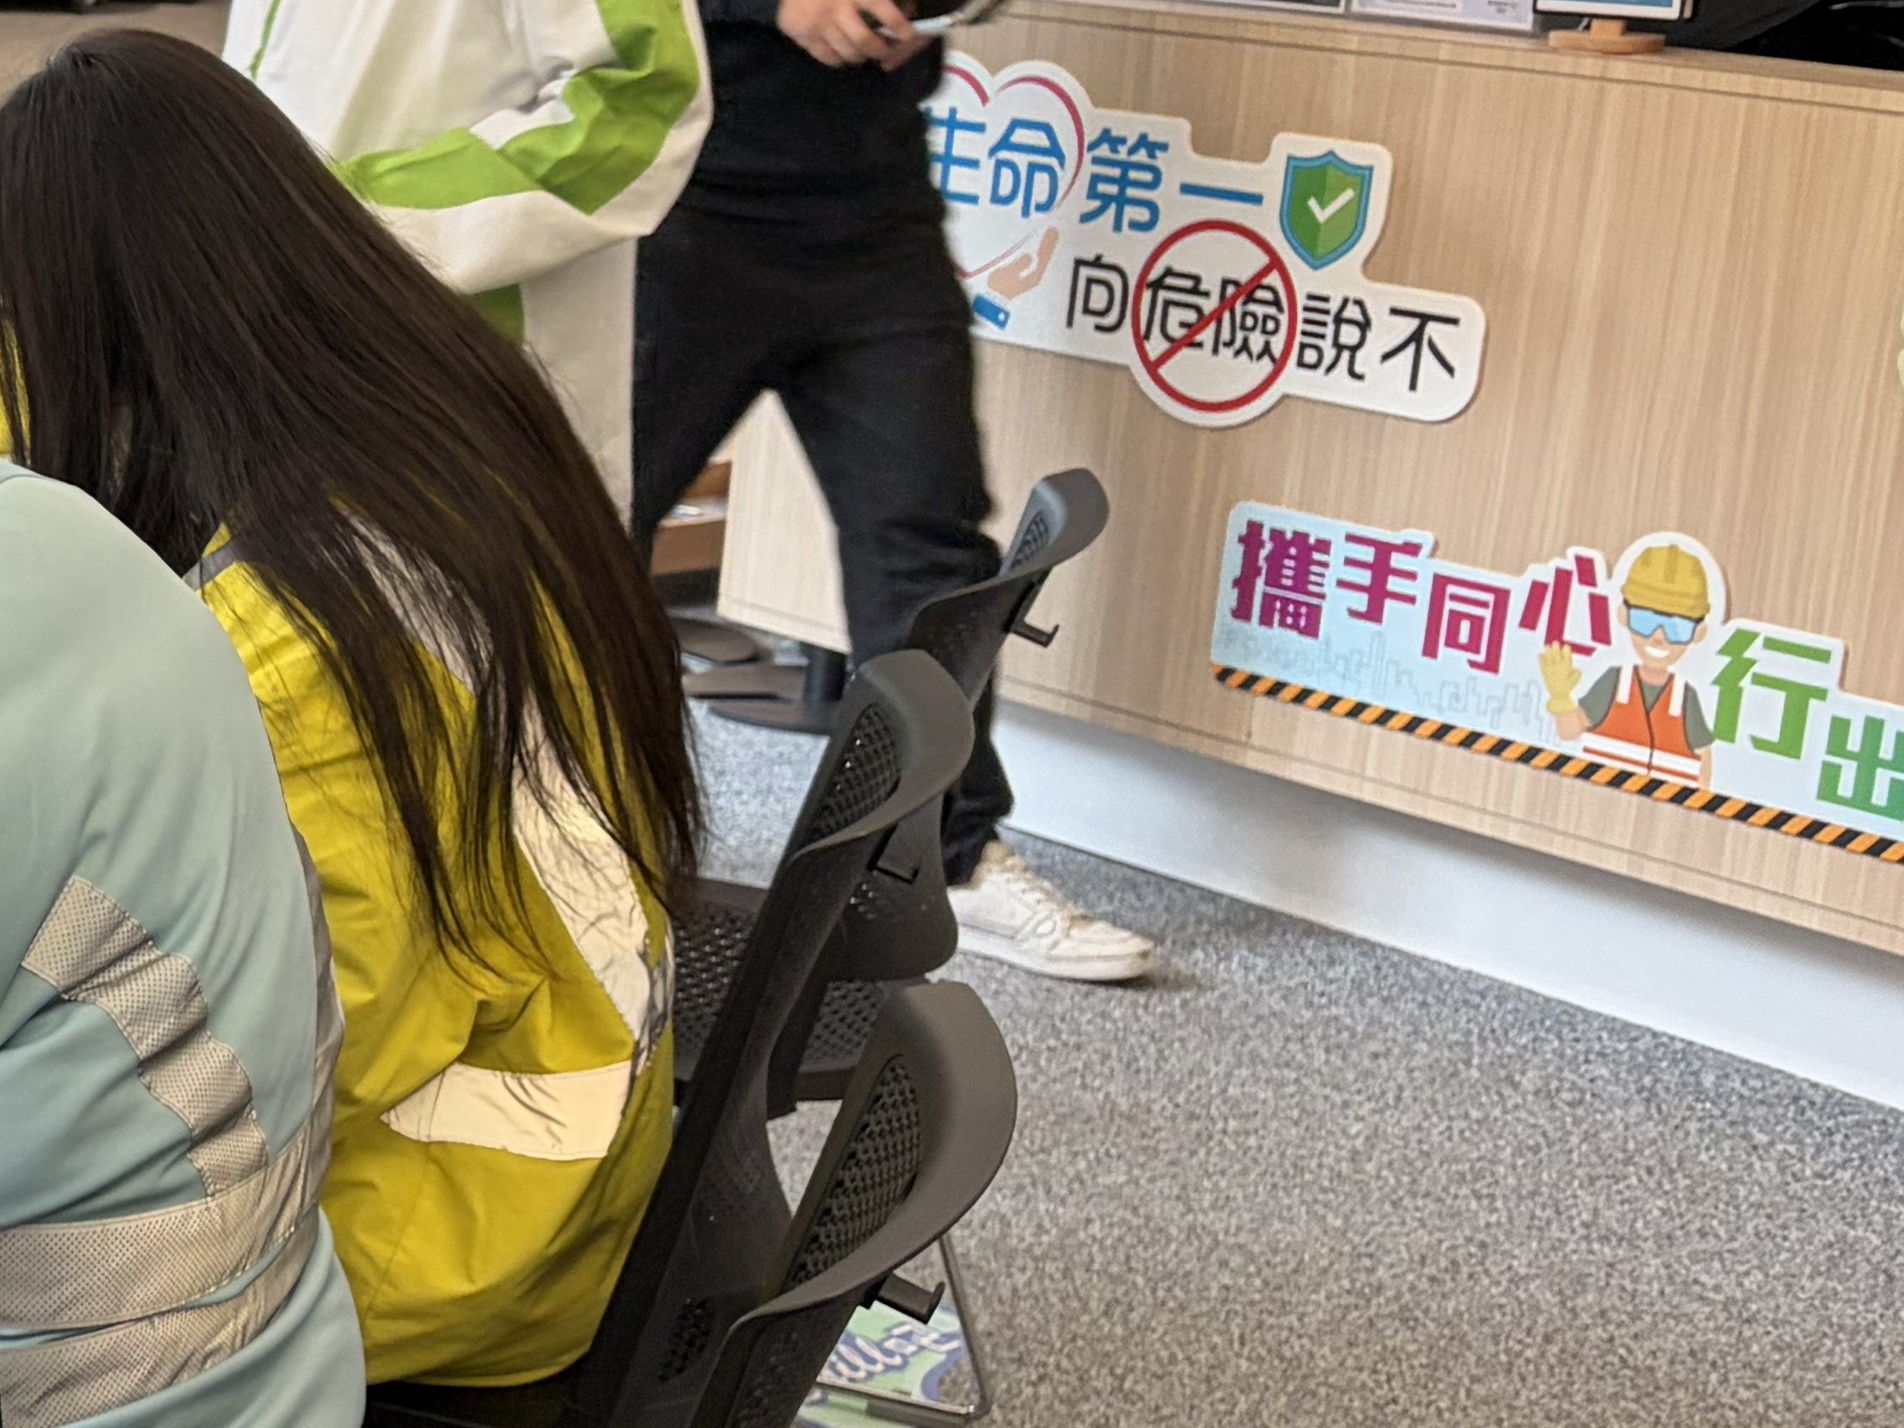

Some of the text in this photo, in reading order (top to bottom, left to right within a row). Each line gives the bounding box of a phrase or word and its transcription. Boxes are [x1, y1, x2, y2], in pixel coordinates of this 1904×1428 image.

[923, 105, 1264, 233] 生命第一
[1065, 253, 1460, 392] 向危險說不
[1230, 518, 1613, 675] 攜手同心
